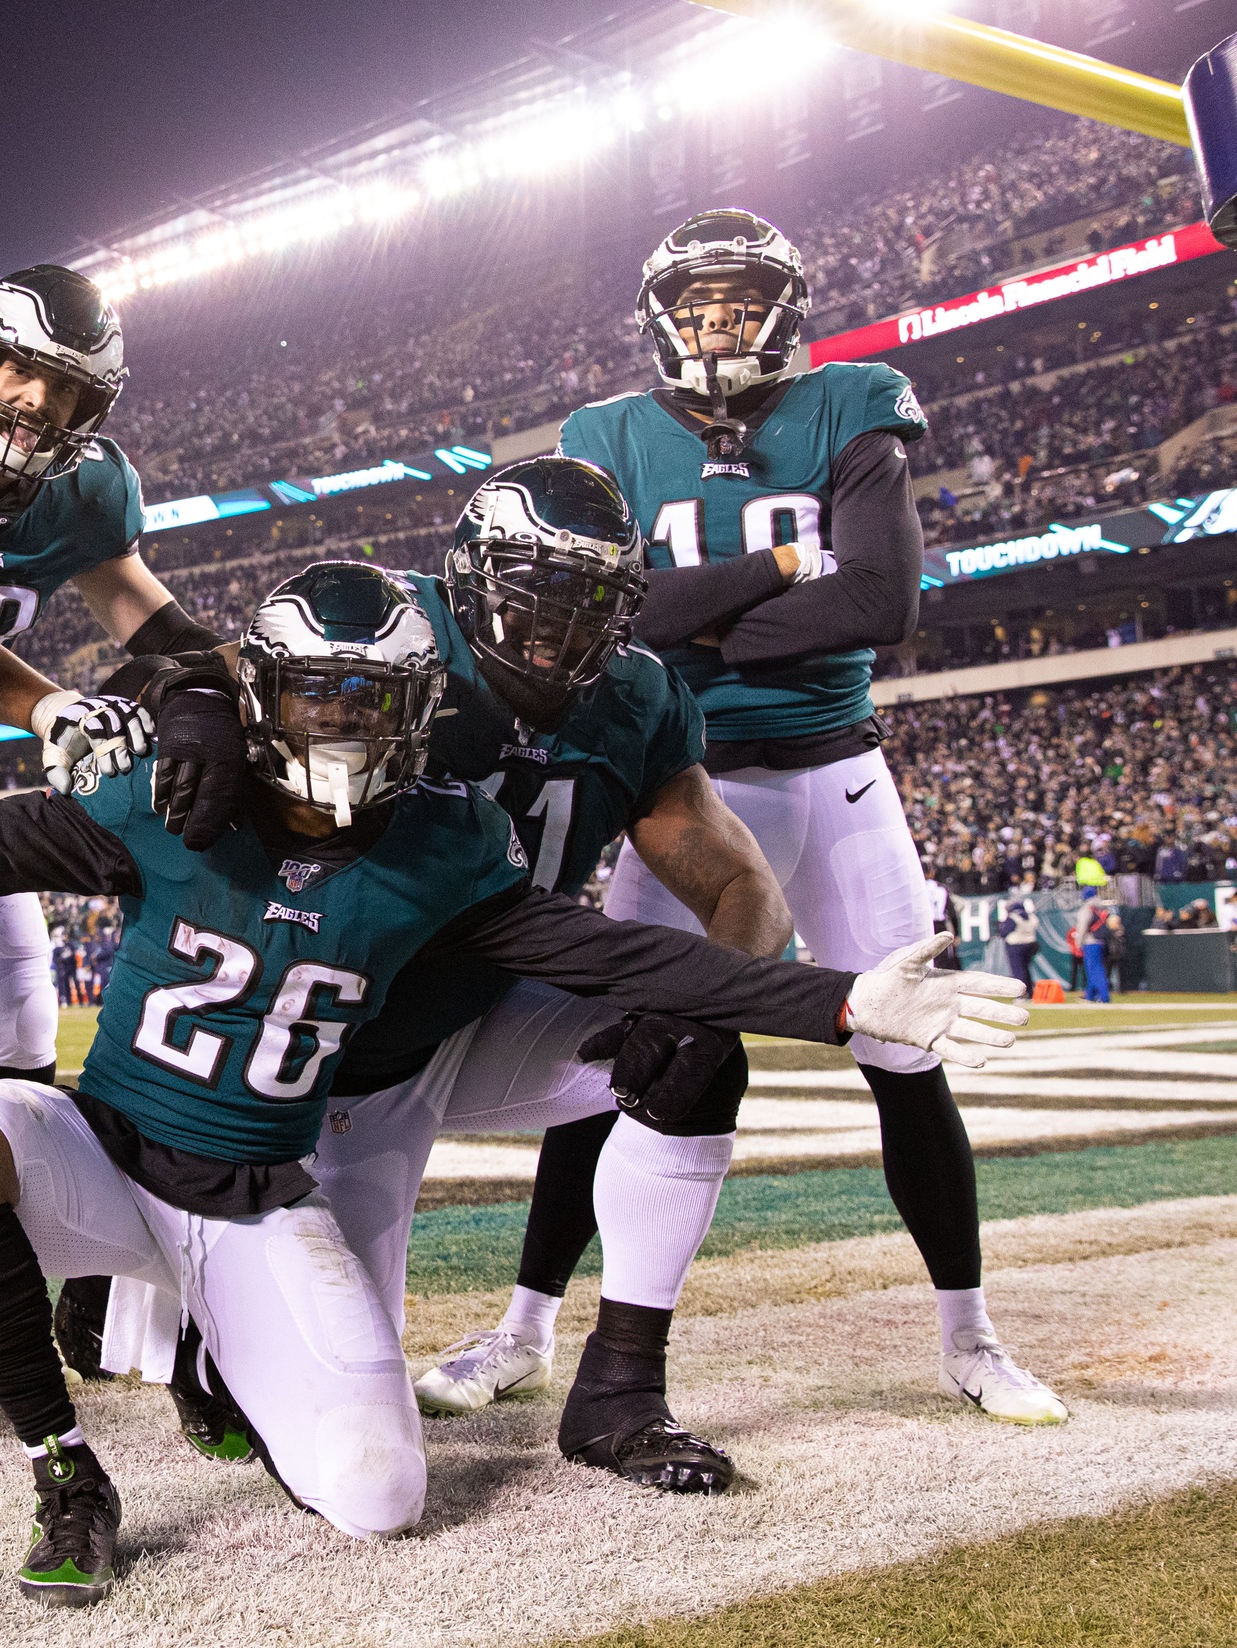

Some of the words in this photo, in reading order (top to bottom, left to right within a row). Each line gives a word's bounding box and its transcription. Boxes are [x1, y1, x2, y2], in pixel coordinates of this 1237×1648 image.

[1109, 233, 1178, 280] Field
[701, 462, 750, 479] EAGLES
[945, 523, 1102, 577] TOUCHDOWN
[499, 743, 549, 765] EAGLES
[264, 901, 321, 933] EAGLES
[134, 921, 367, 1099] 26
